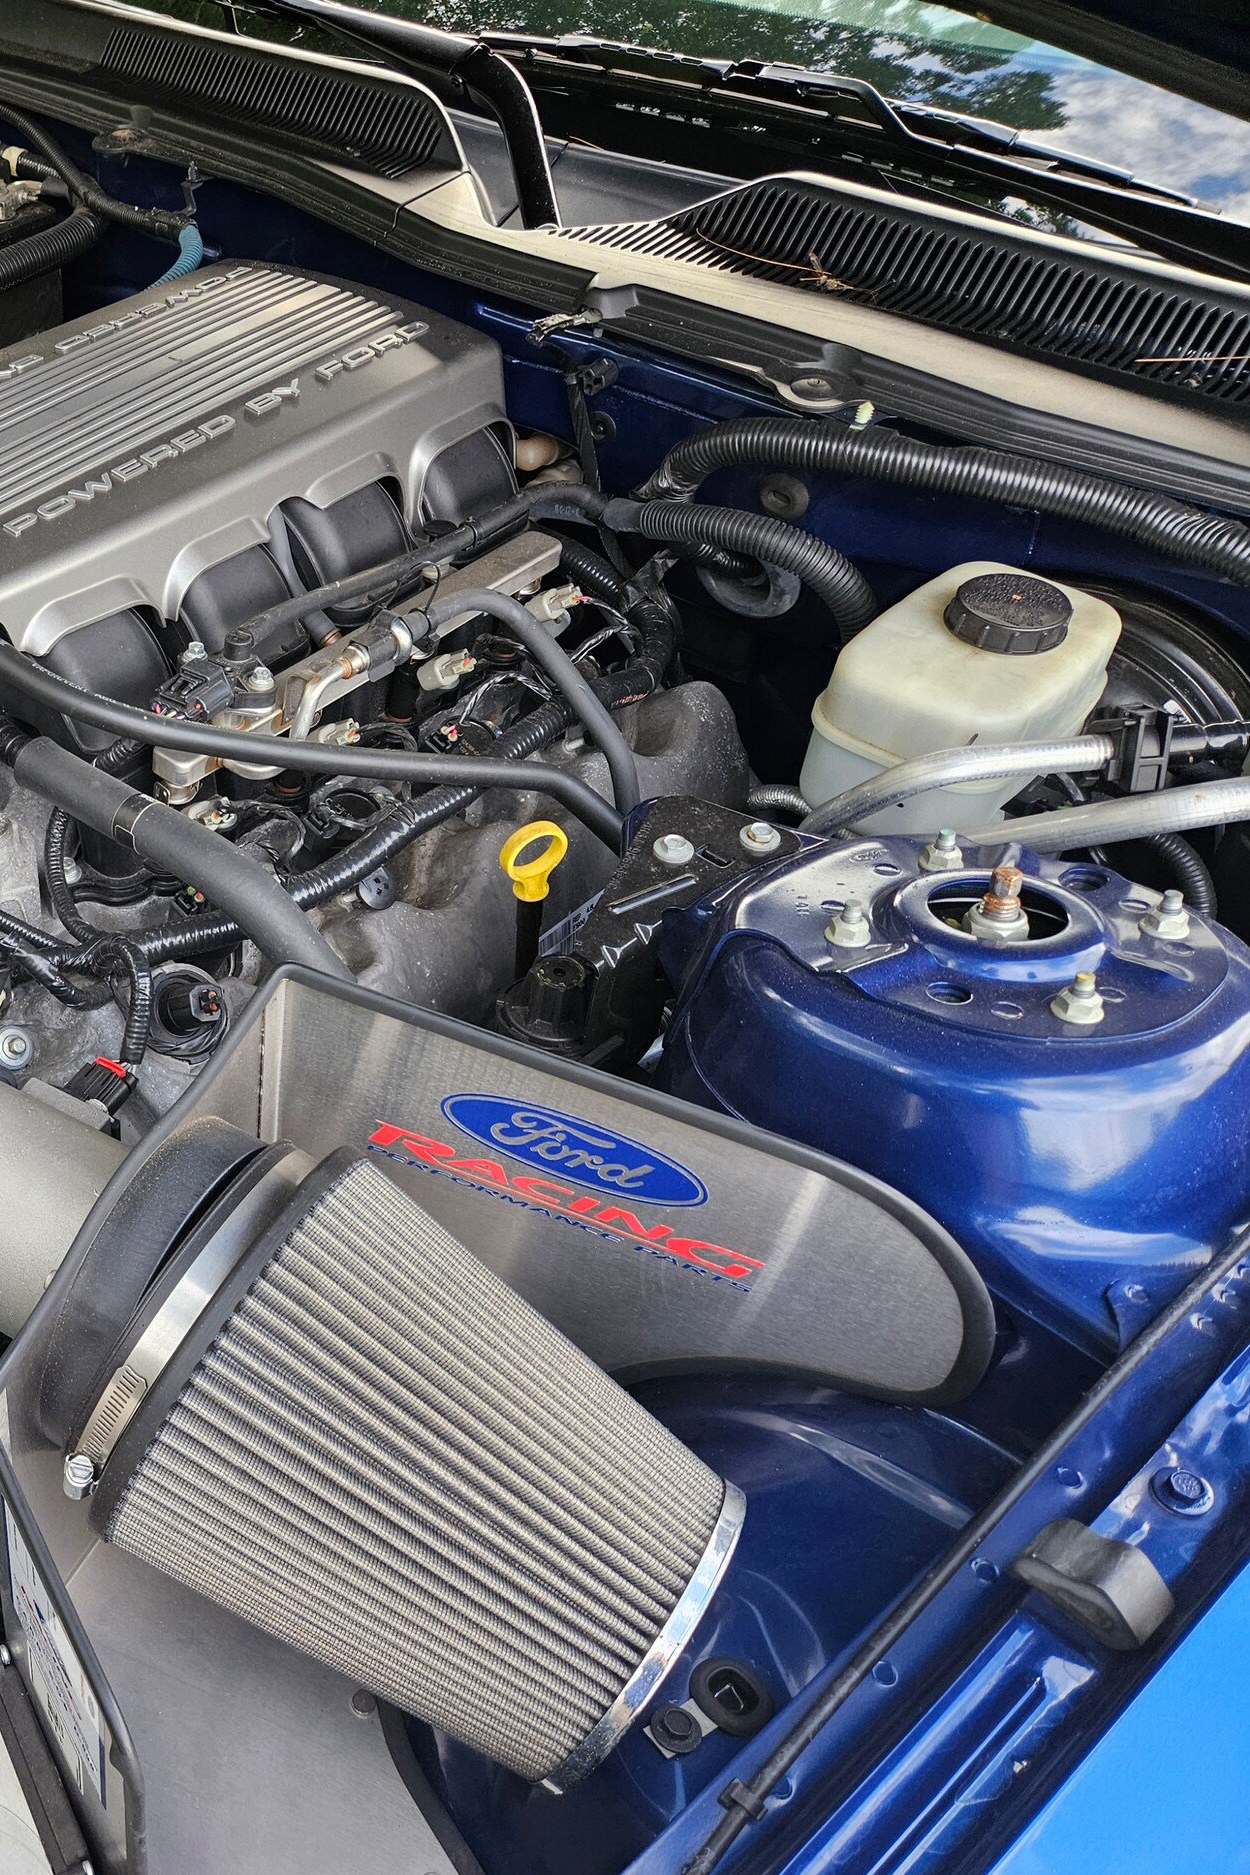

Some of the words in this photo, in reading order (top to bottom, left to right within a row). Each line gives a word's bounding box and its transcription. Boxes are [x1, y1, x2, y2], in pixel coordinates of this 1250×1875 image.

[54, 267, 251, 353] POWERED
[3, 414, 236, 538] POWERED
[245, 378, 302, 416] BY
[314, 320, 431, 382] FORD
[366, 1145, 626, 1244] PERFORMANCE
[634, 1244, 755, 1293] PARTS
[368, 1119, 766, 1279] RACING
[491, 1110, 655, 1189] Ford
